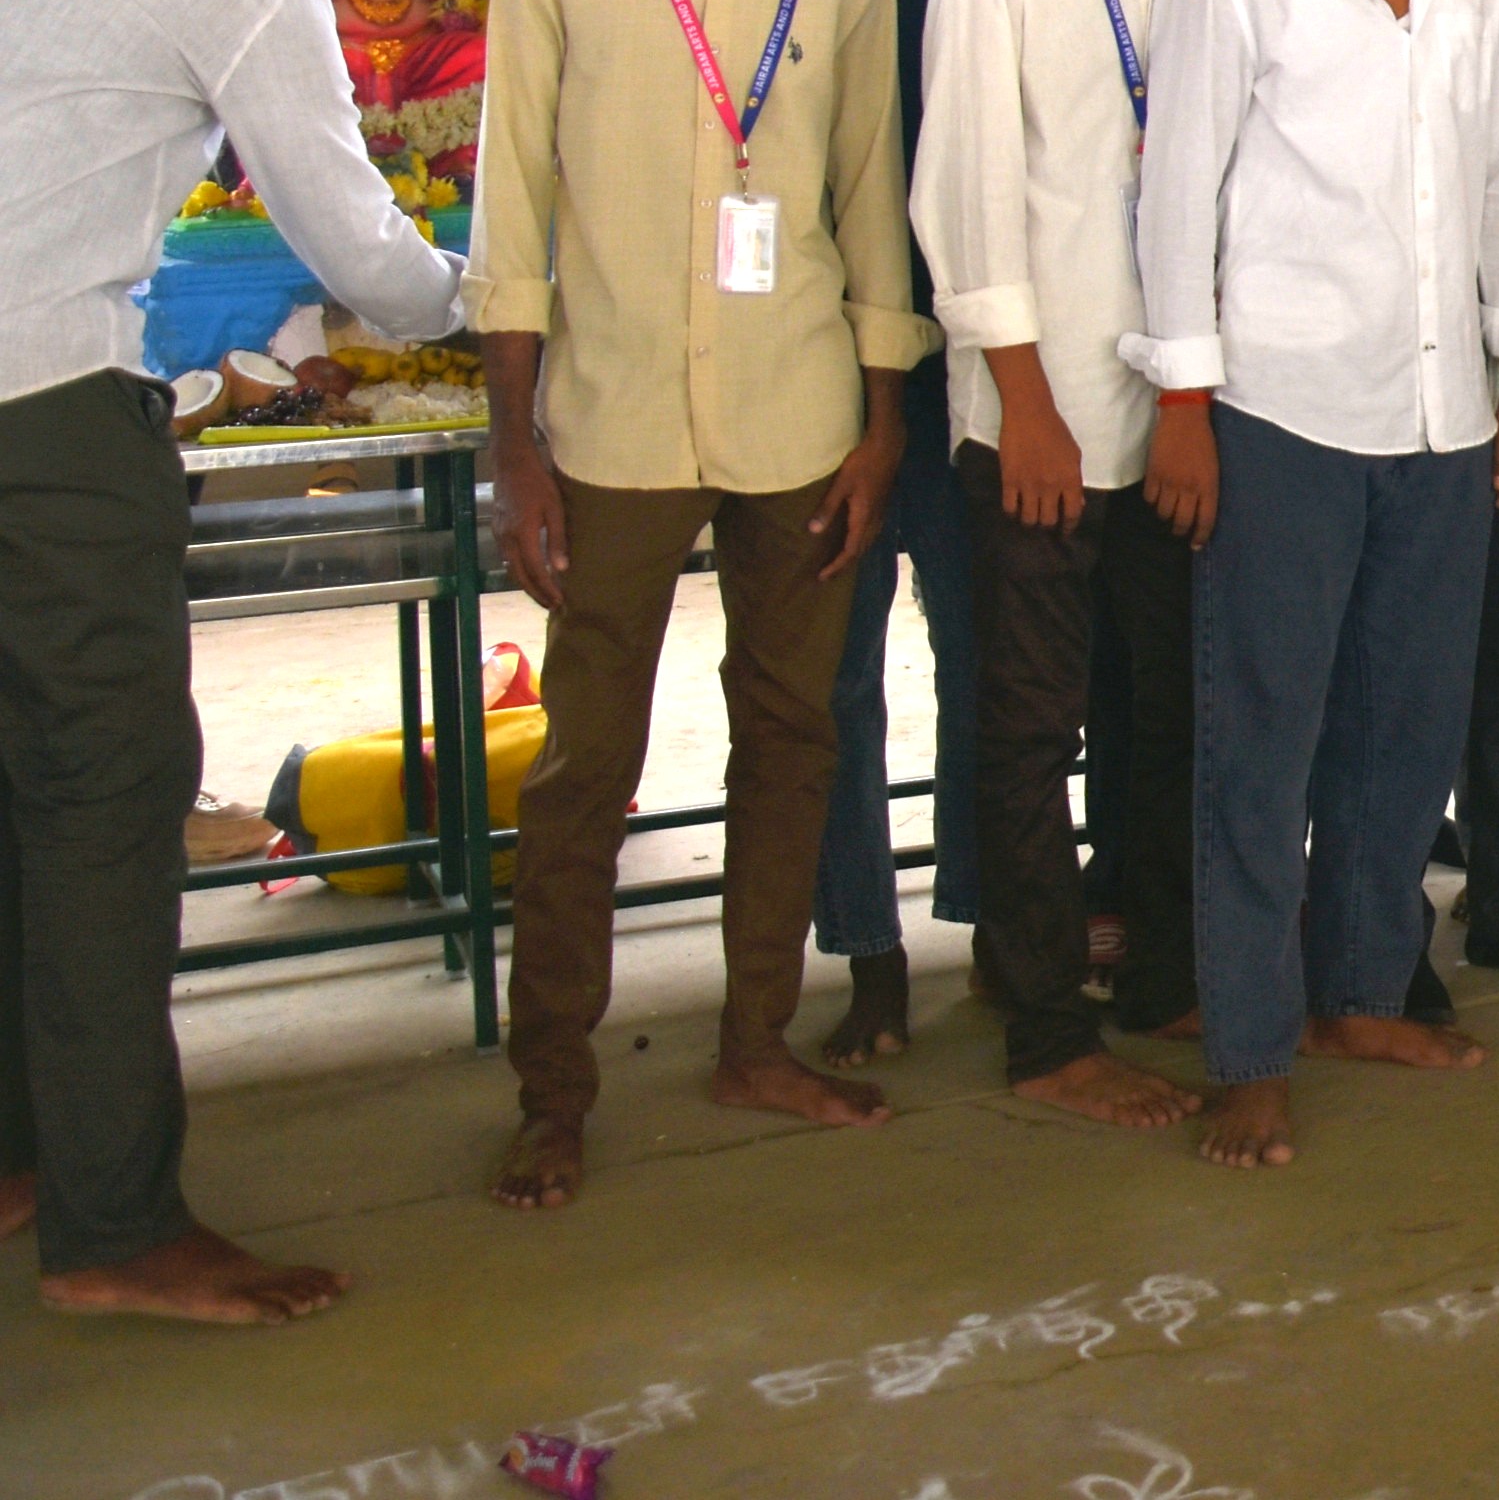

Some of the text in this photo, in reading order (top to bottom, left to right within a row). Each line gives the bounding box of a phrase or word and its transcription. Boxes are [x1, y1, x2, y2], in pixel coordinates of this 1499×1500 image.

[678, 4, 694, 24] AND
[687, 26, 704, 50] ARTS
[1117, 20, 1131, 45] ARTS
[753, 56, 772, 93] JAIRAM
[767, 31, 782, 56] ARTS
[776, 9, 790, 30] AND
[1124, 45, 1142, 82] JAIRAM
[697, 51, 719, 88] JAIRAM
